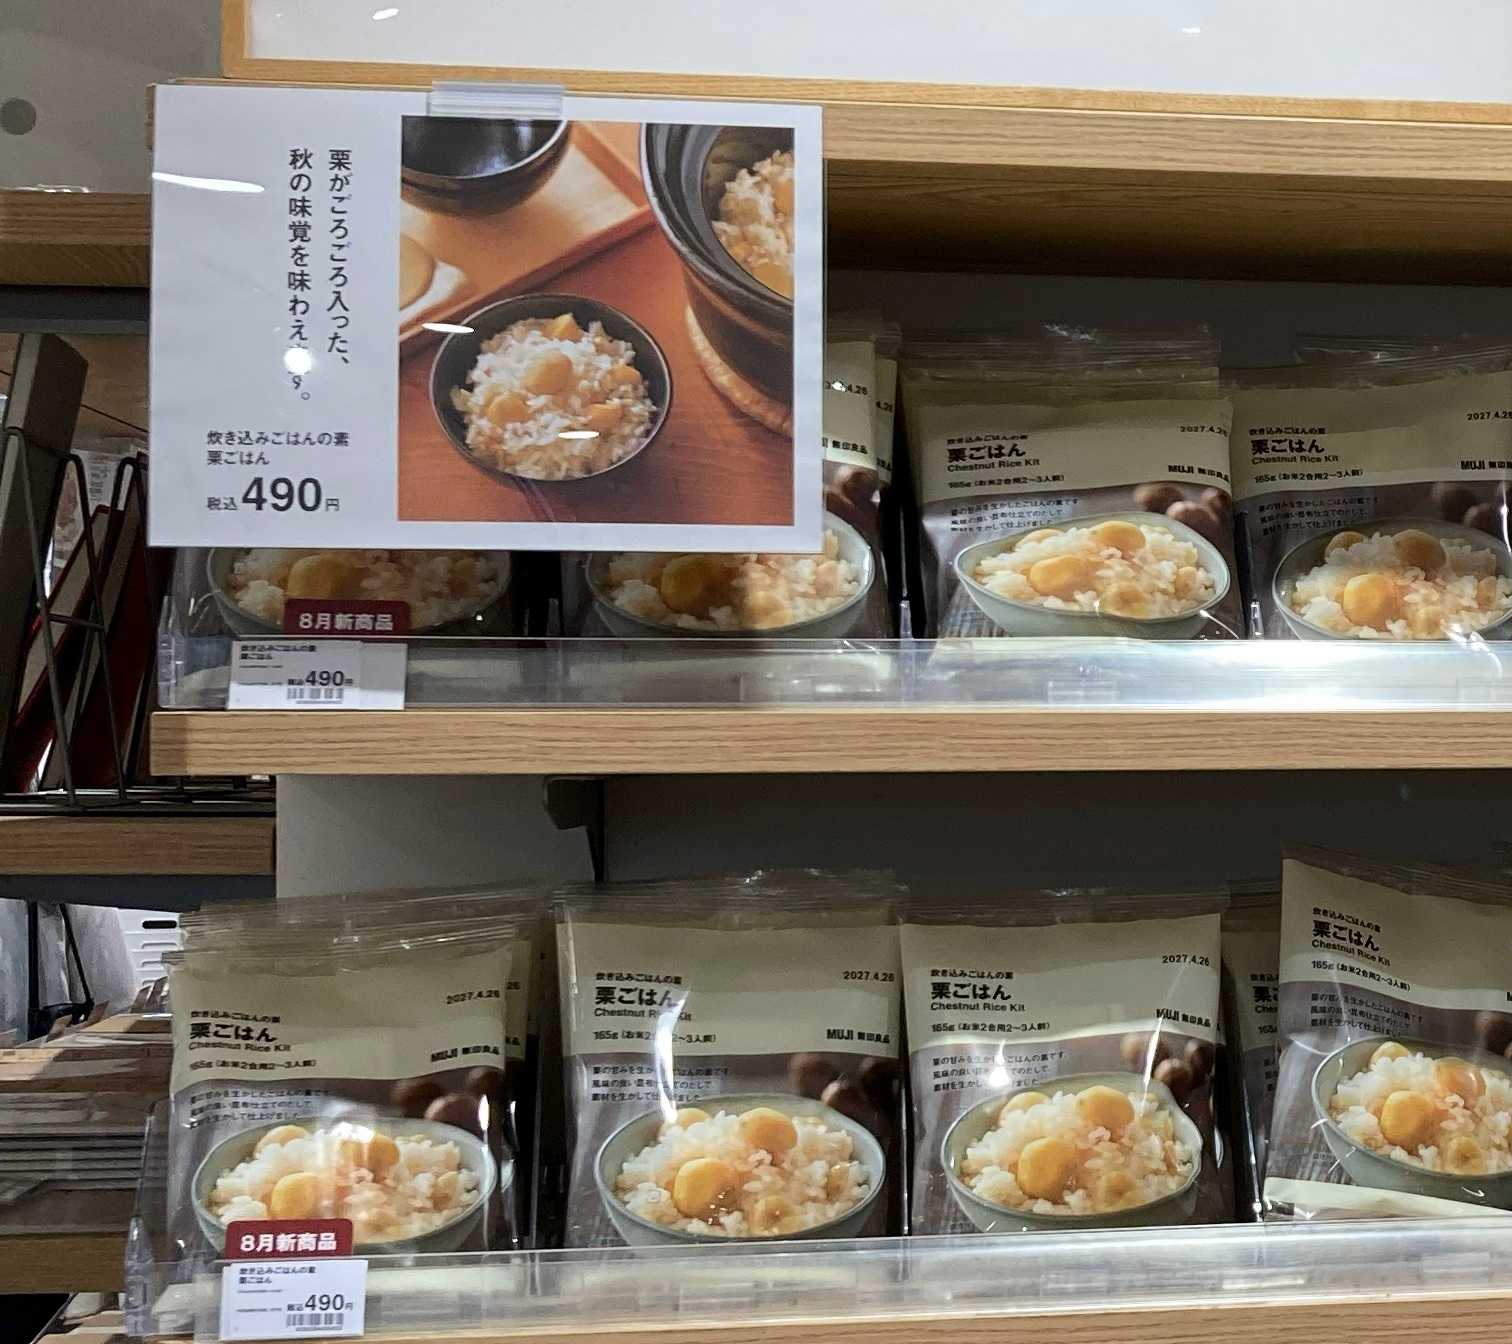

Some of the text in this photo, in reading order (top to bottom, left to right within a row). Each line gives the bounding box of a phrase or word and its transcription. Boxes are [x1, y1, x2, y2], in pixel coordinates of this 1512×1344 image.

[327, 149, 352, 364] 栗がごろごろ入った、
[287, 148, 312, 401] 秋の味覚を味わえす。
[207, 431, 349, 447] 炊き込みごはんの素
[1251, 439, 1325, 454] 栗ごはん
[207, 450, 270, 466] 栗ごはん
[948, 444, 1026, 463] 栗ごはん
[300, 614, 394, 631] 8月新商品
[1312, 920, 1379, 952] 栗ごはん
[595, 986, 679, 1006] 栗ごはん
[930, 982, 1012, 1000] 栗ごはん
[930, 1002, 1025, 1012] Chestnut Rice Kit
[190, 1022, 278, 1042] 栗ごはん
[826, 1029, 854, 1040] MUJI
[240, 1233, 337, 1253] 8月新商品
